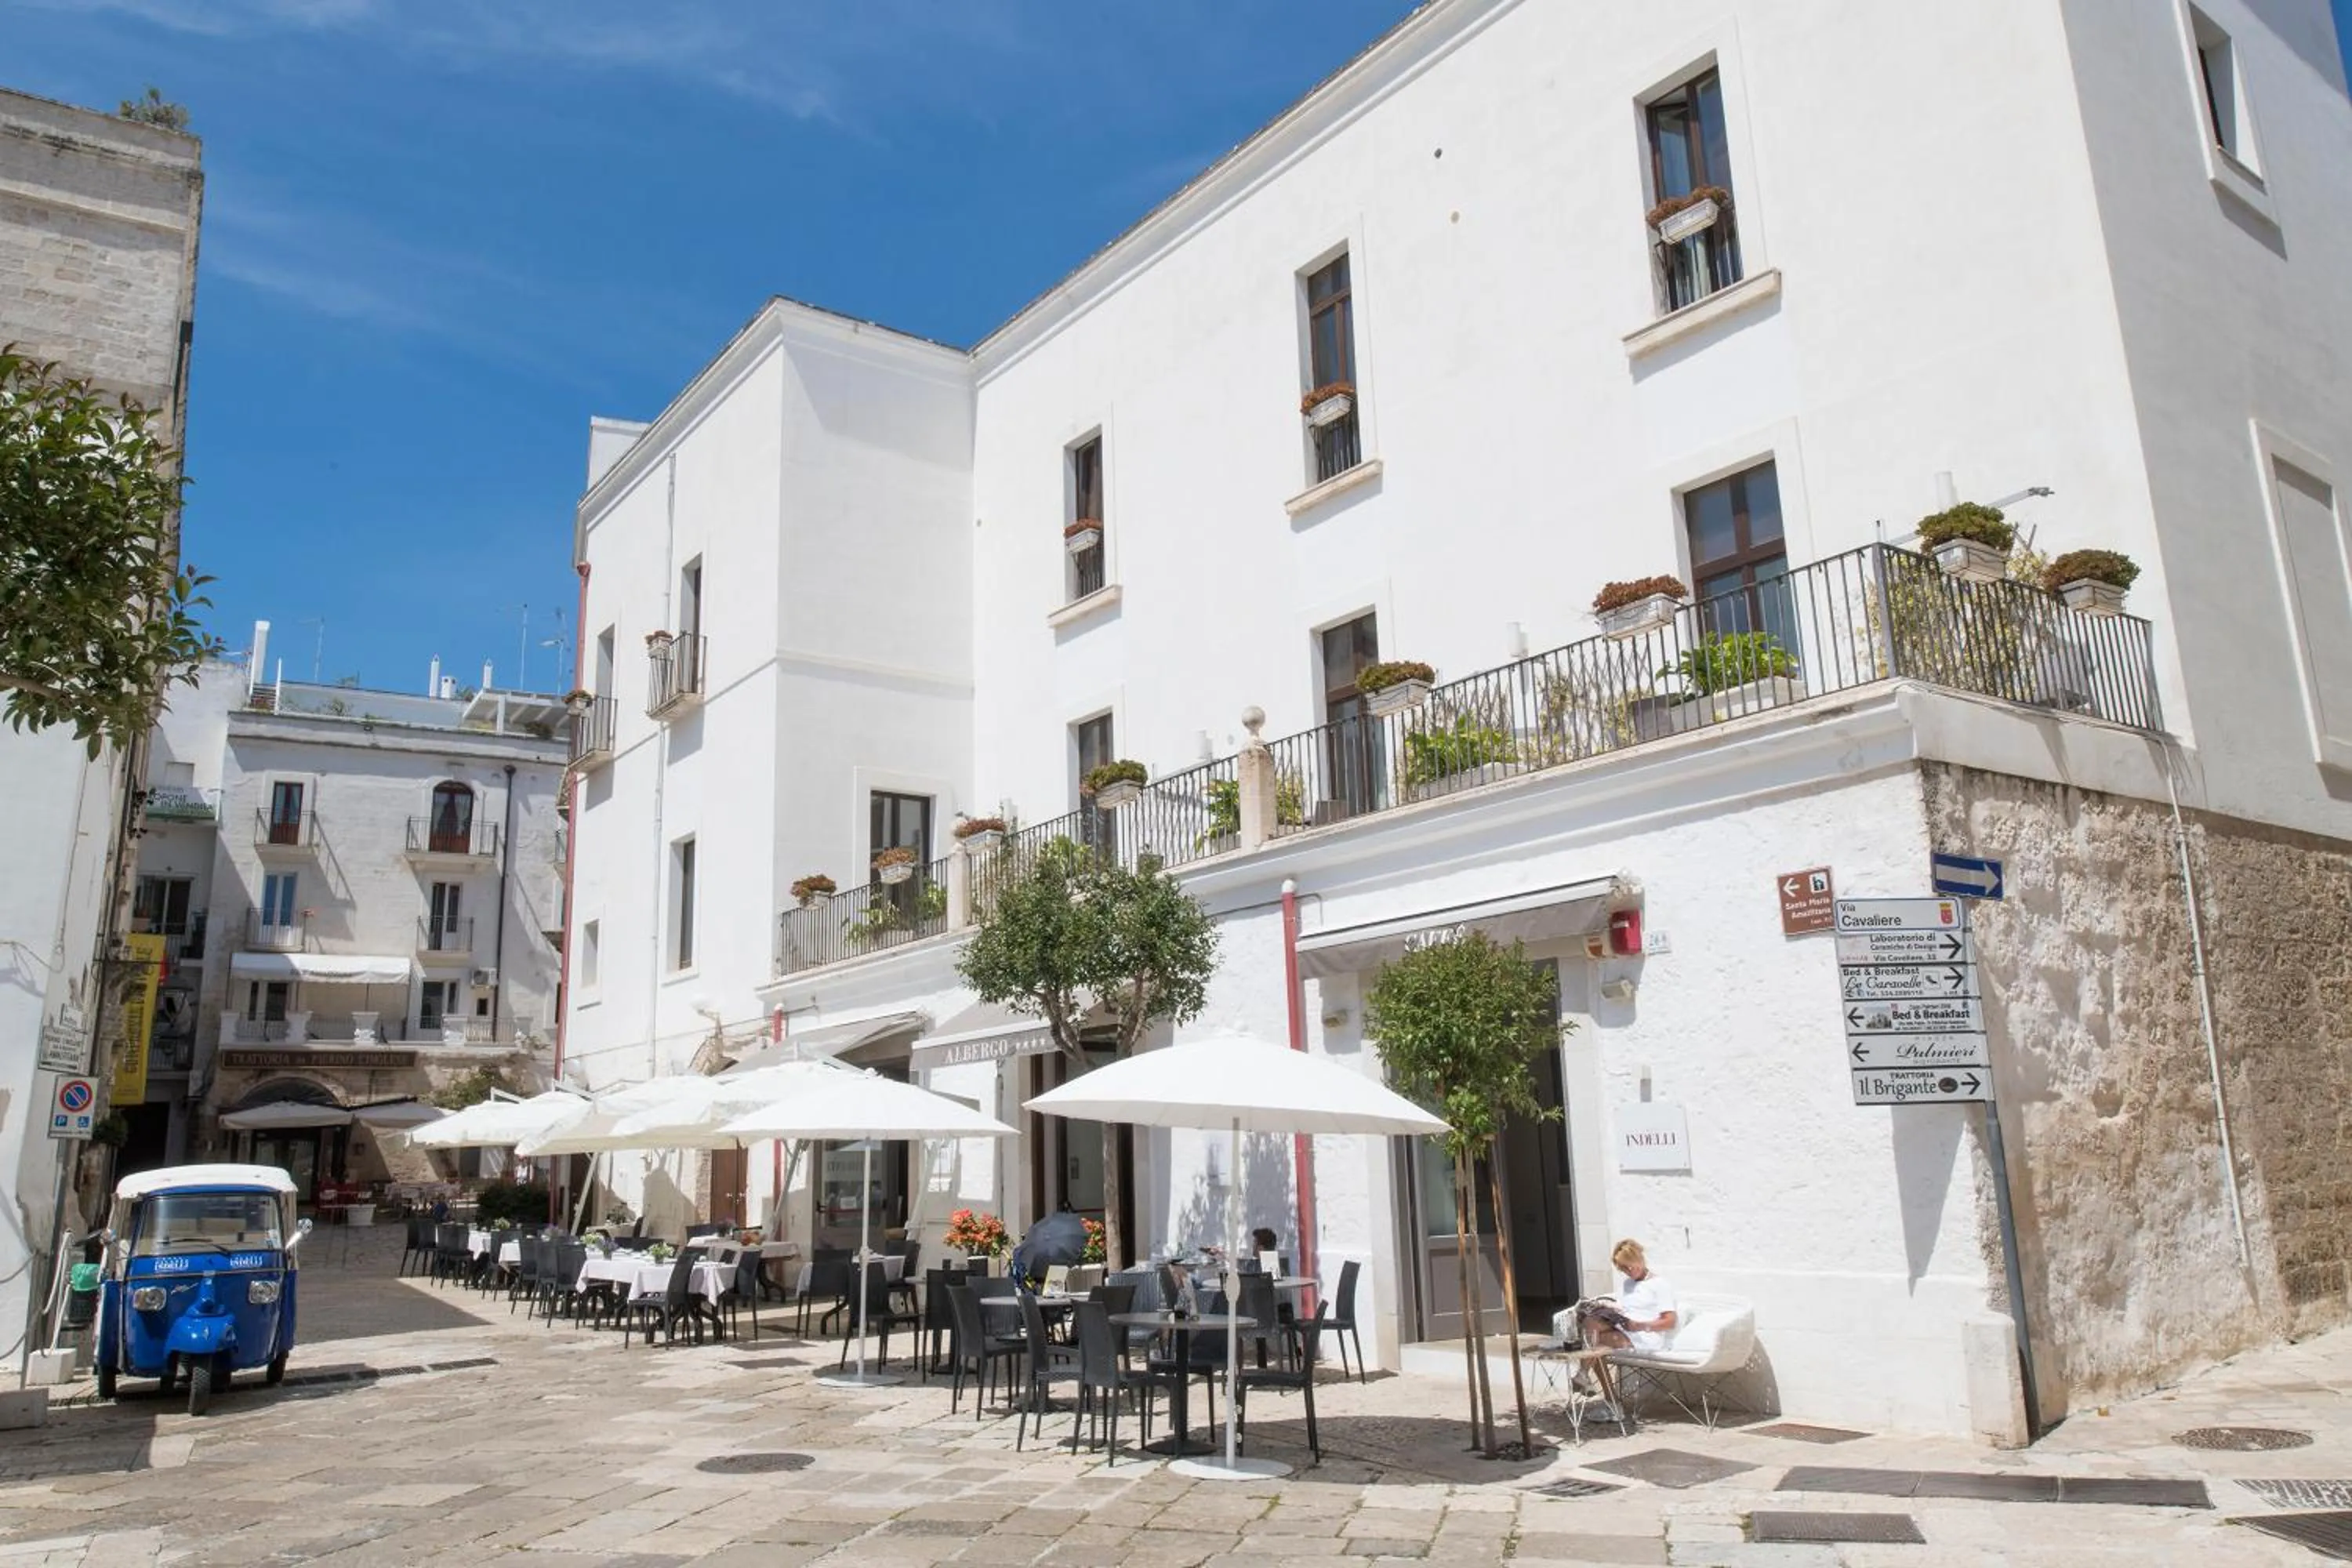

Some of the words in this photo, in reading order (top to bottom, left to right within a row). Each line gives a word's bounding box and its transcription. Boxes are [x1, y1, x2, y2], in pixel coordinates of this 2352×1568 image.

[1841, 903, 1855, 912] Via
[1842, 913, 1901, 927] Cavaliere
[1869, 933, 1925, 943] Laboratorio
[1926, 932, 1936, 942] di
[1864, 967, 1871, 976] &
[1875, 966, 1919, 976] Breakfast
[1892, 1011, 1911, 1019] Bed
[1914, 1010, 1922, 1019] &
[1923, 1009, 1970, 1019] Breakfast
[945, 1039, 1008, 1064] ALBERGO
[231, 1053, 289, 1065] TRATTORIA
[1859, 1076, 1871, 1095] Il
[1874, 1078, 1937, 1100] Brigante
[1626, 1132, 1675, 1146] INDELLI
